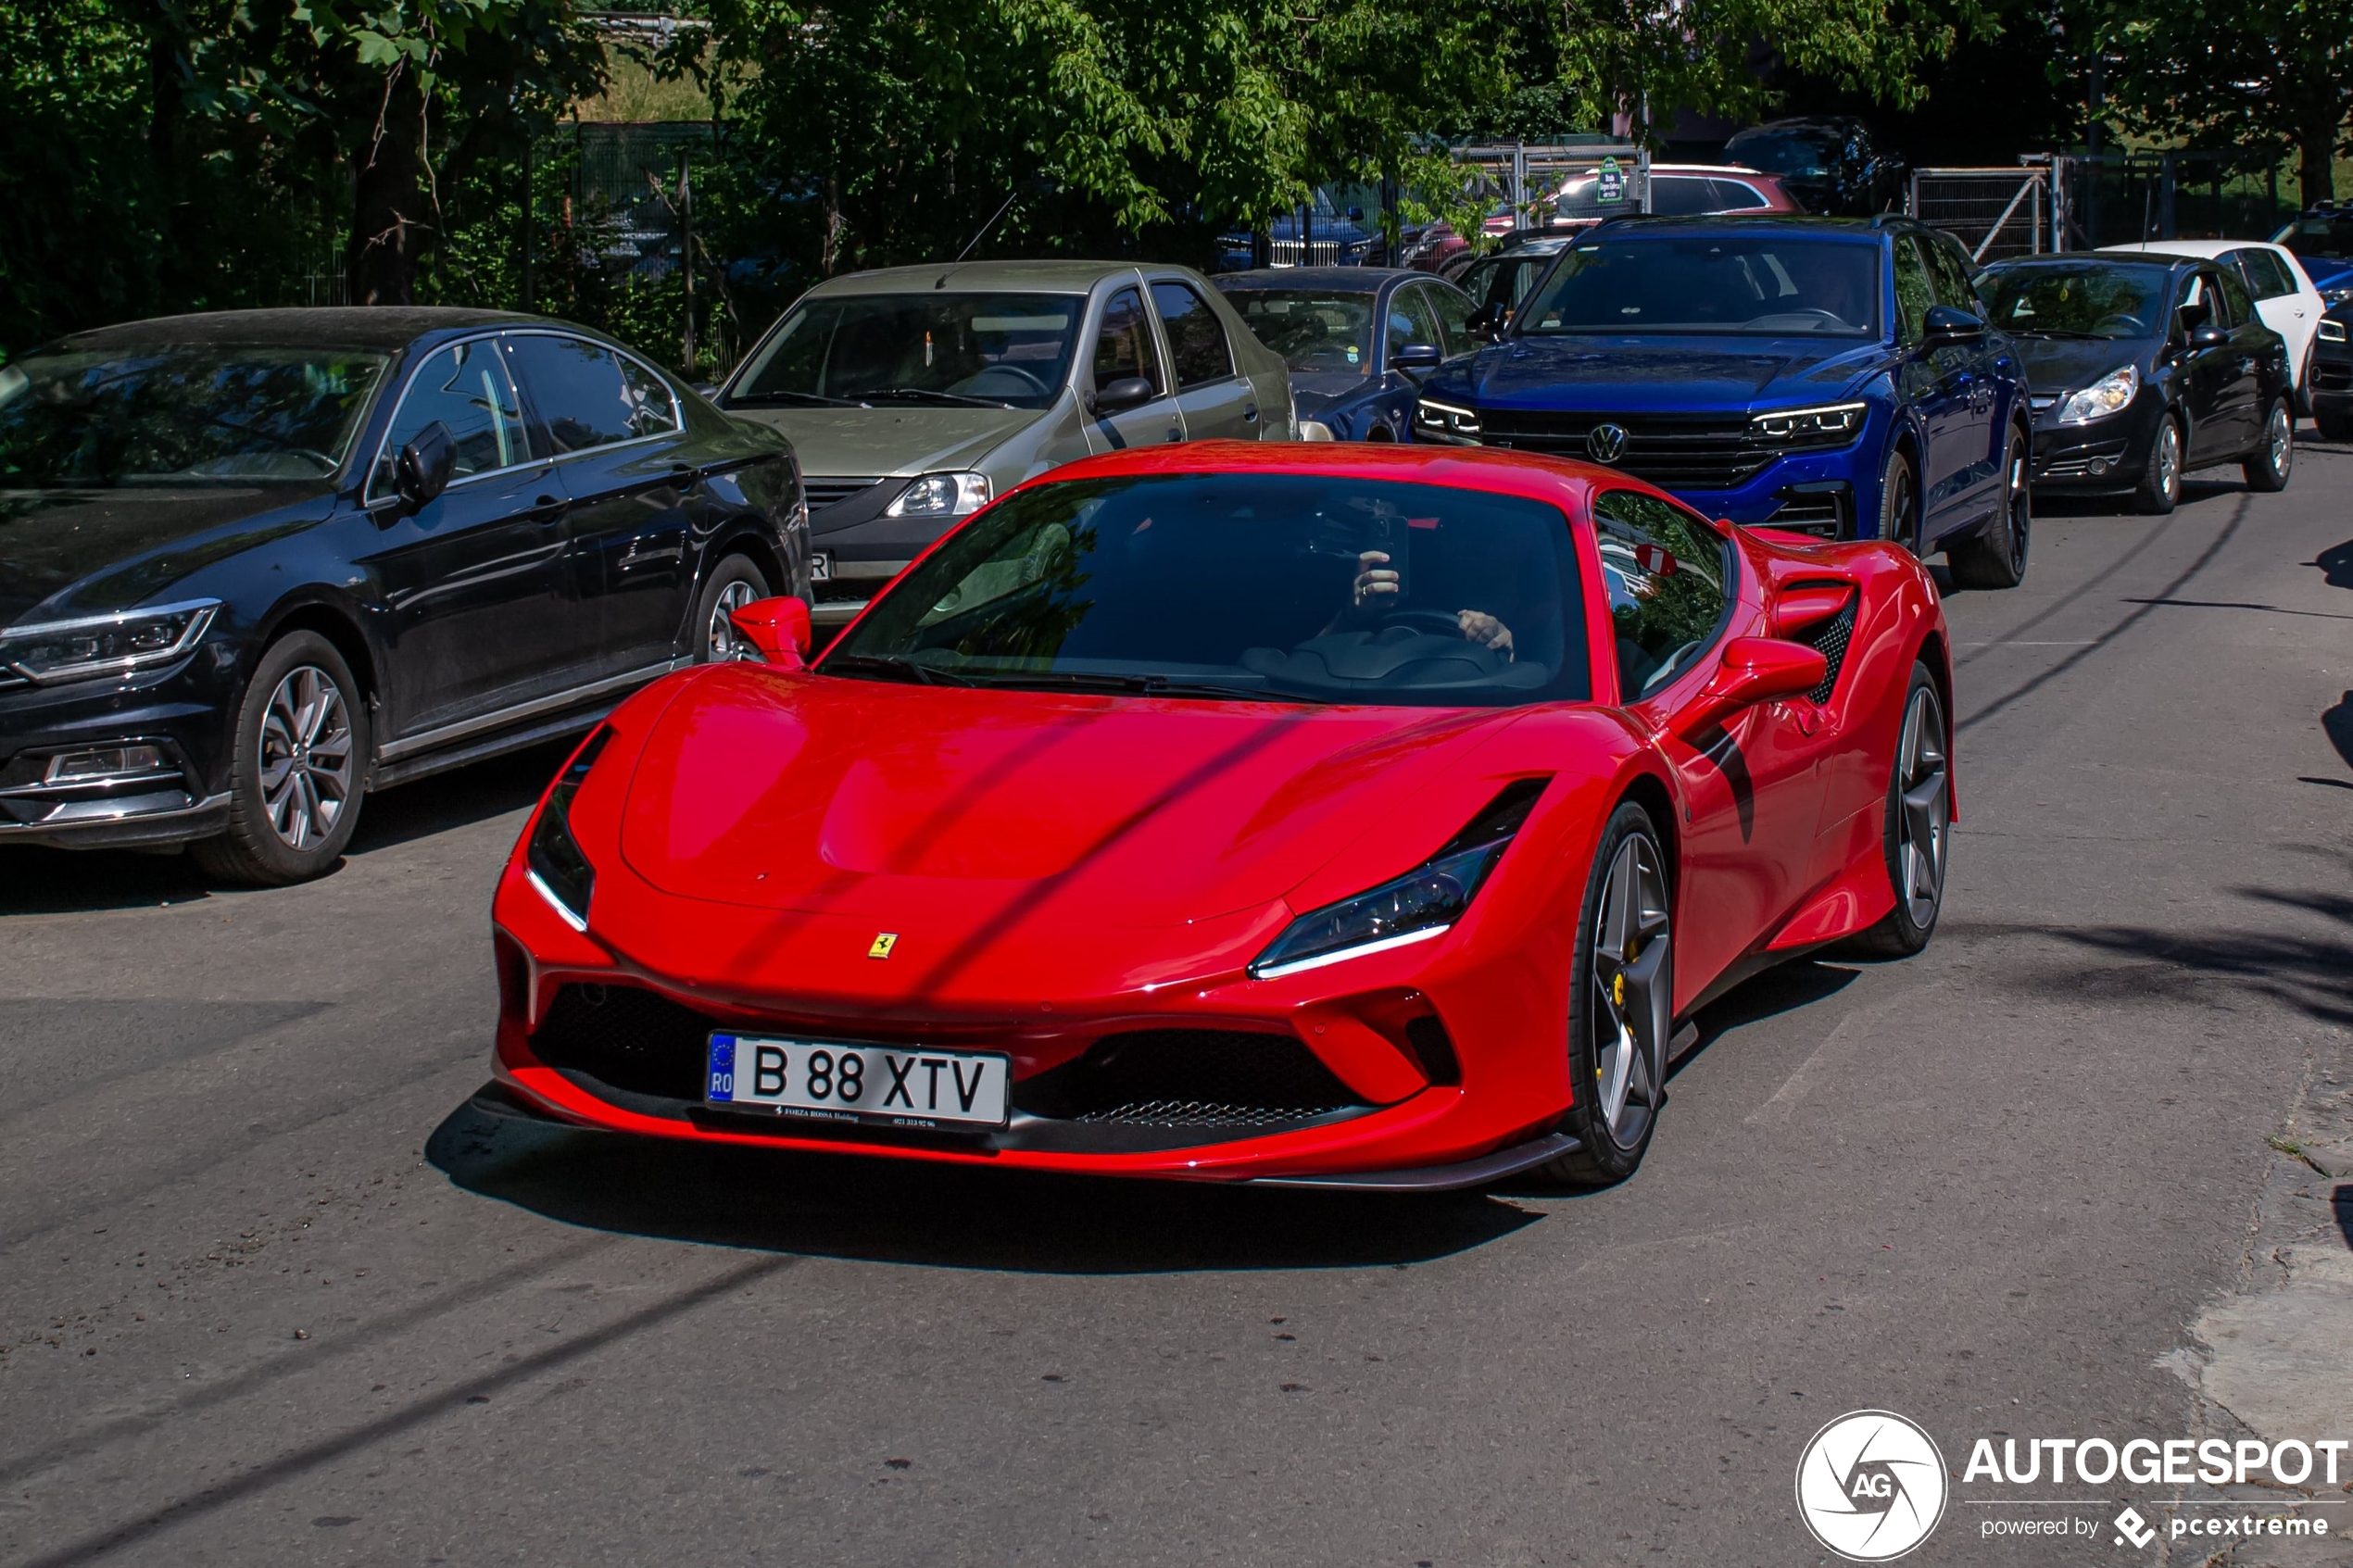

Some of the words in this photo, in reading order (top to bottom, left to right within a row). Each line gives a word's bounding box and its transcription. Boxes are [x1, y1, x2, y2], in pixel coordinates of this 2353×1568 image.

[1589, 425, 1624, 461] VW
[712, 1073, 733, 1093] RO
[753, 1045, 788, 1097] B
[807, 1048, 865, 1103] 88
[883, 1054, 986, 1113] XTV
[785, 1108, 809, 1117] FORZA
